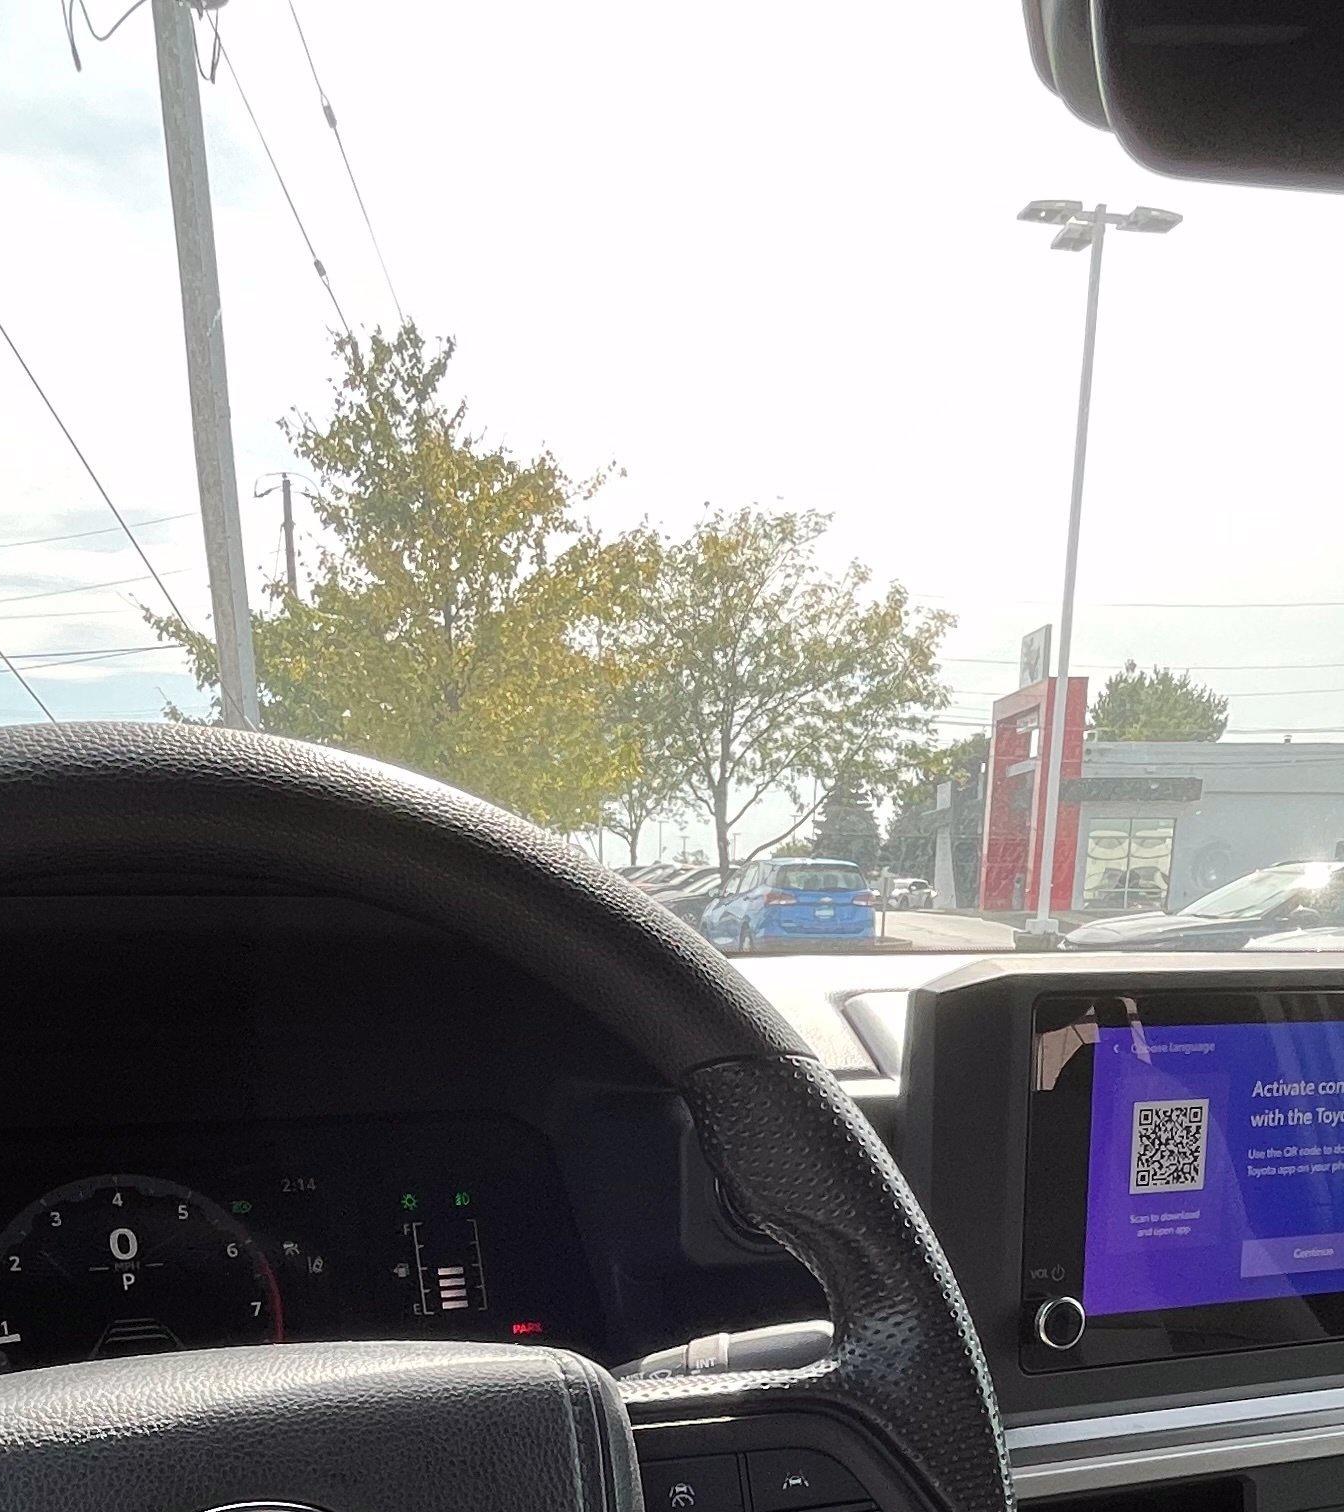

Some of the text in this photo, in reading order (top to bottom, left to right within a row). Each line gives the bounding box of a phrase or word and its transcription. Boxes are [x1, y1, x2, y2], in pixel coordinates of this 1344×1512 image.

[1251, 1080, 1315, 1098] Activate
[1250, 1110, 1284, 1127] with
[1288, 1109, 1312, 1126] the
[1248, 1148, 1265, 1159] Use
[1267, 1147, 1282, 1158] the
[1323, 1146, 1332, 1155] to
[1247, 1164, 1276, 1178] Toyota
[1309, 1163, 1330, 1174] your
[112, 1192, 124, 1207] 4
[49, 1211, 62, 1227] 3
[177, 1204, 189, 1220] 5
[109, 1227, 138, 1261] 0
[226, 1242, 239, 1258] 6
[8, 1255, 22, 1272] 2
[122, 1273, 136, 1291] P
[1029, 1268, 1049, 1280] VOL
[250, 1301, 262, 1317] 7
[0, 1320, 10, 1335] 1
[695, 1356, 716, 1369] INT
